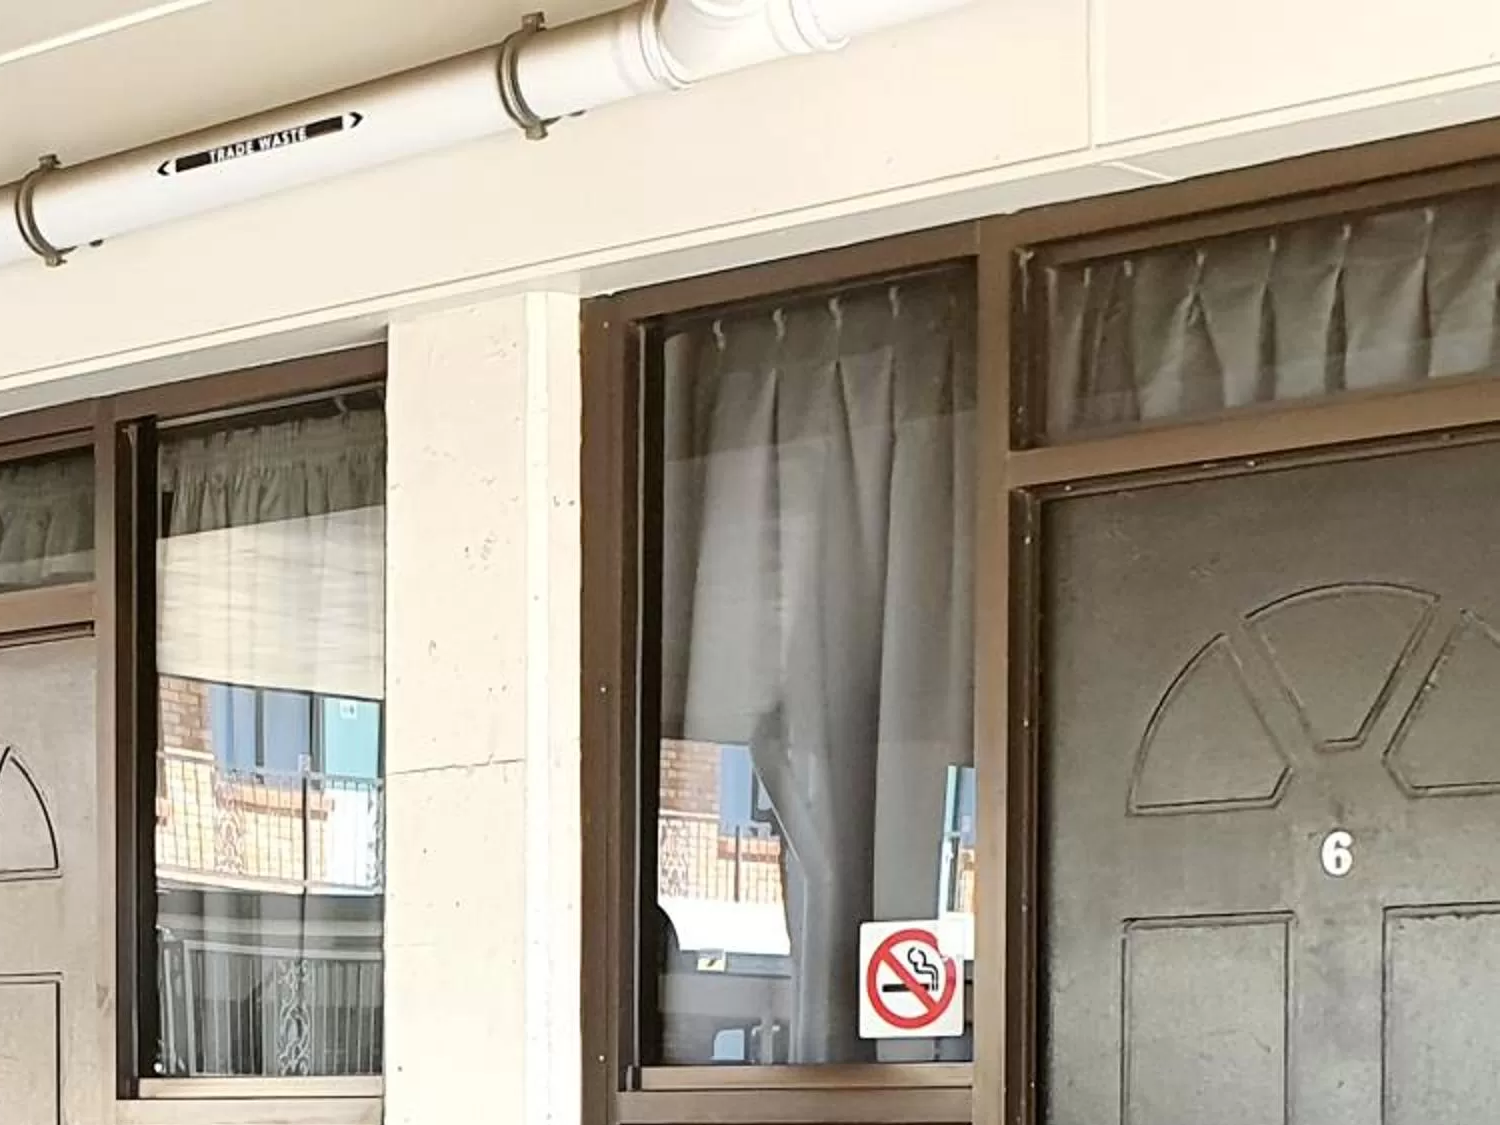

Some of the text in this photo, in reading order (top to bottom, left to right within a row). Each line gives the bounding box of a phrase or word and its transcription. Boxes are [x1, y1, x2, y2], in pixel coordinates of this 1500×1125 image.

[209, 126, 307, 164] TRADE WASTE
[1321, 830, 1354, 876] 6
